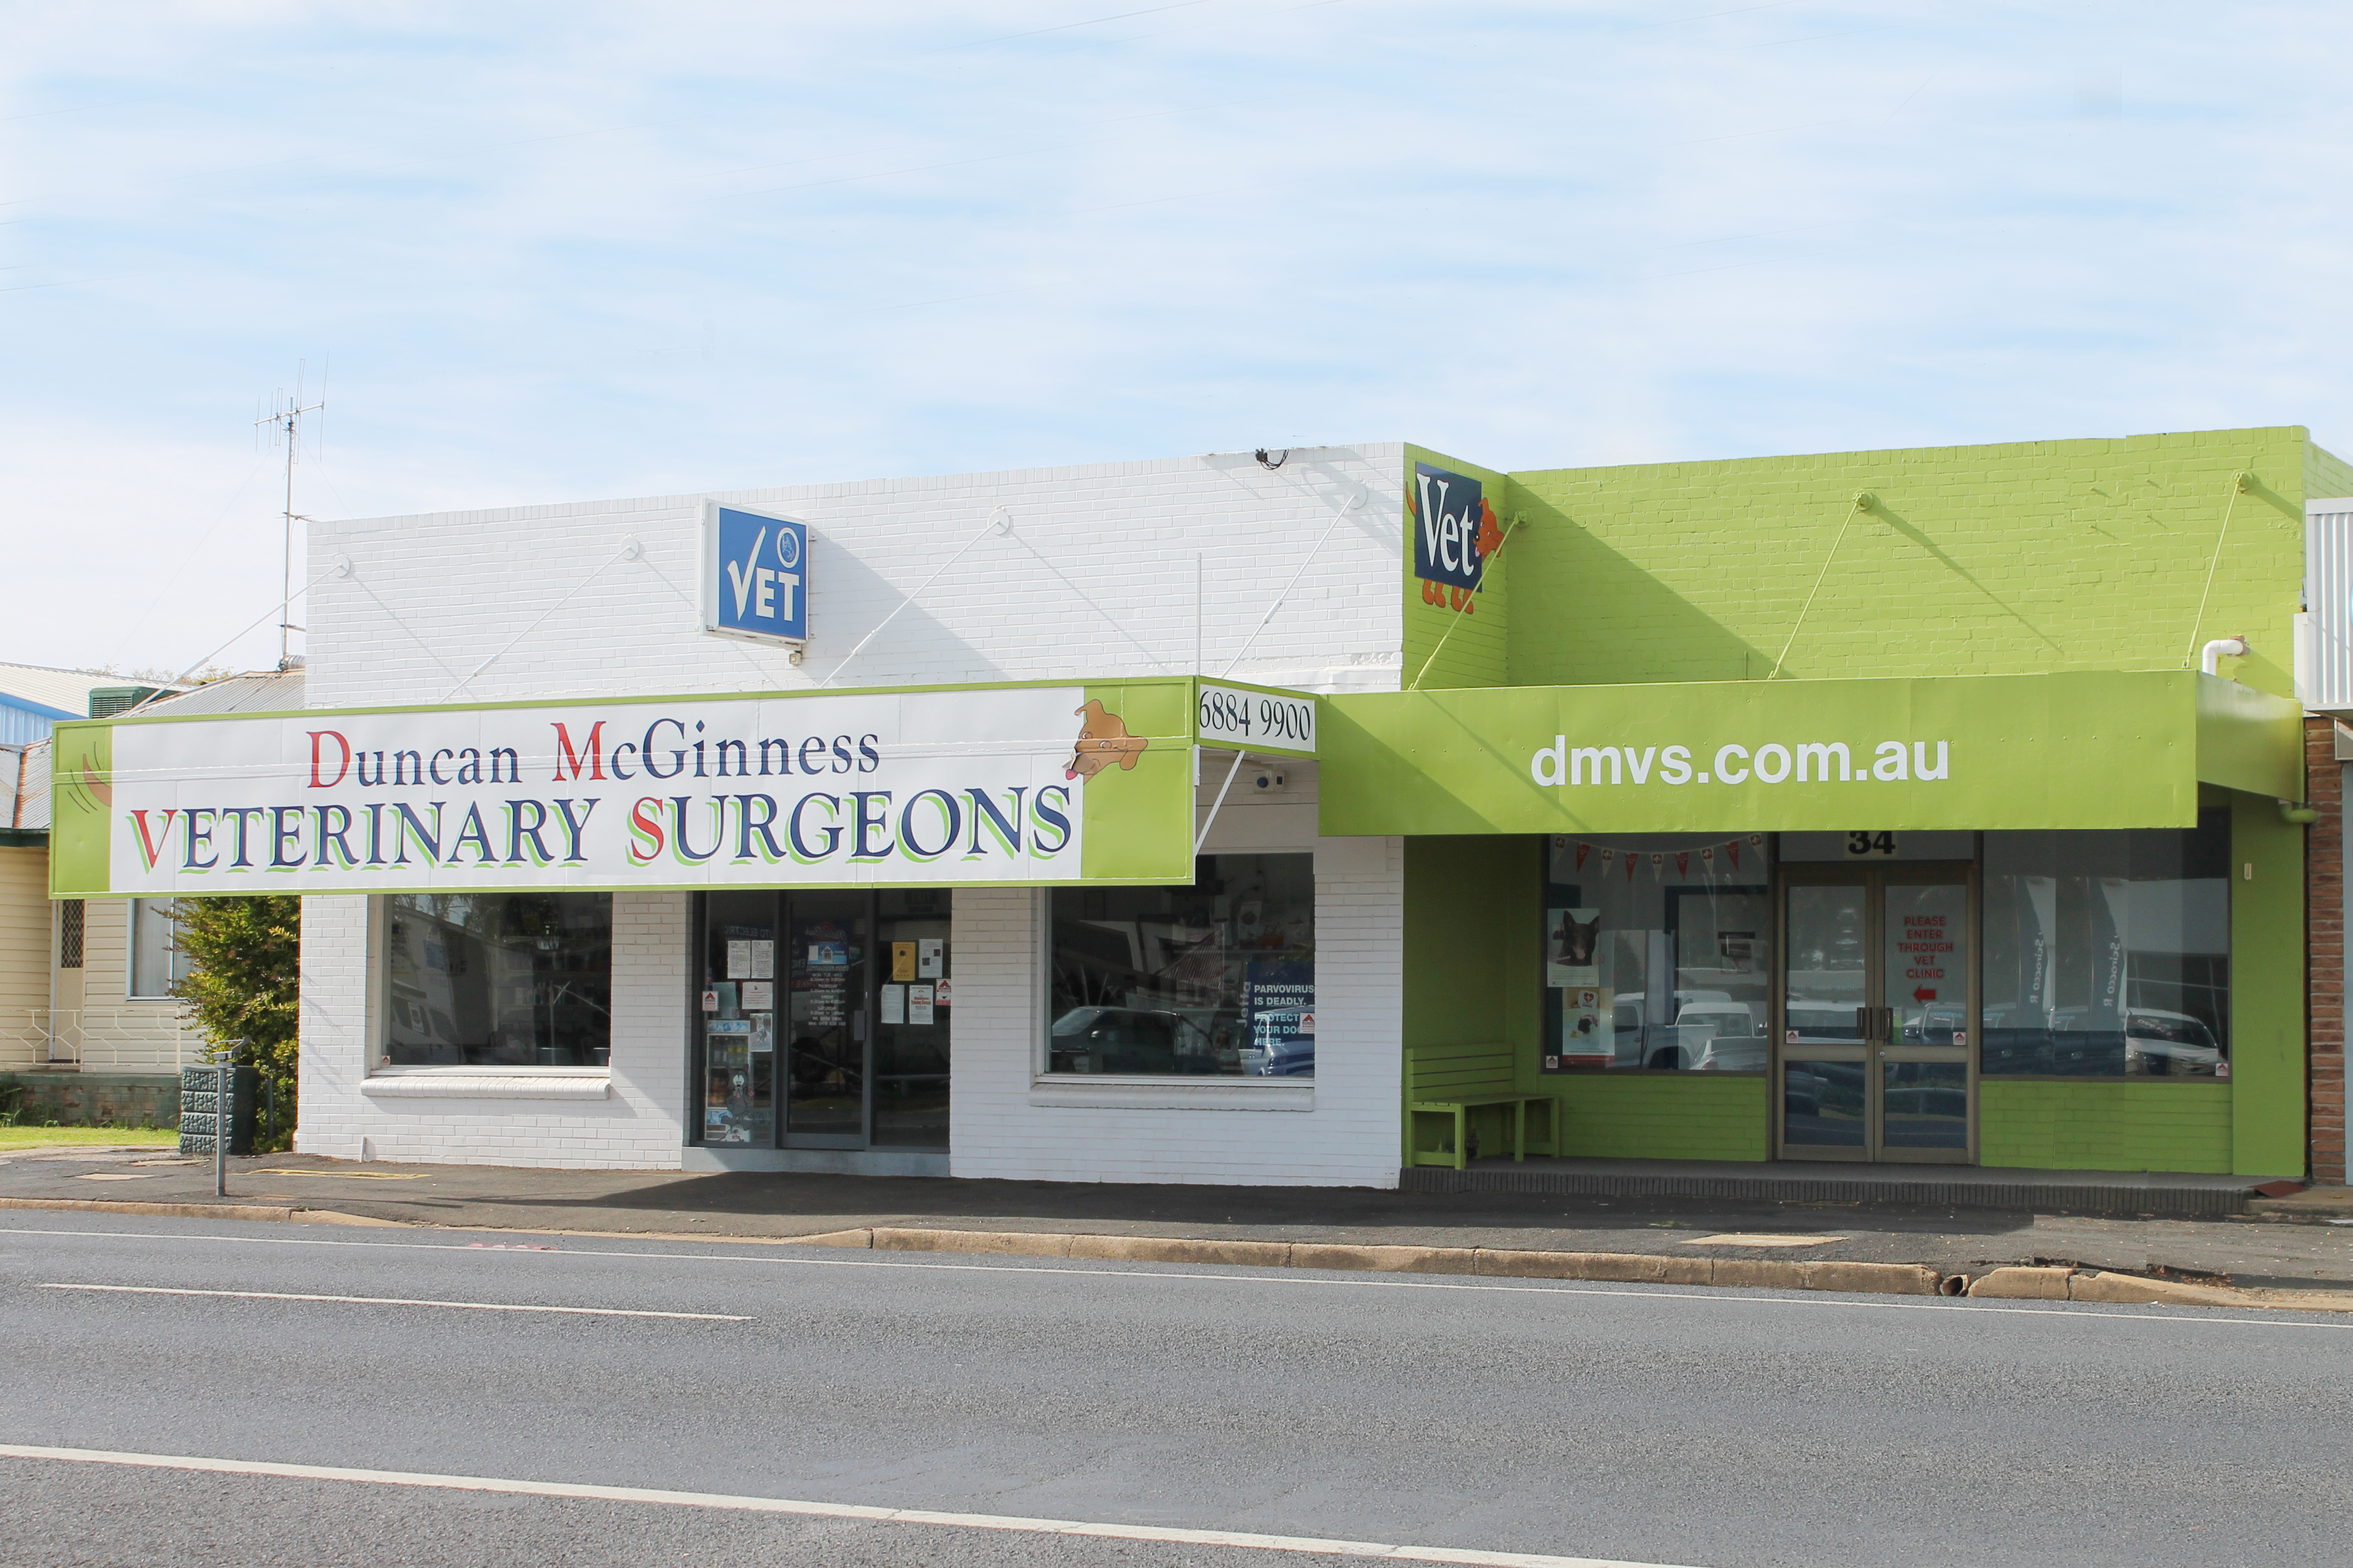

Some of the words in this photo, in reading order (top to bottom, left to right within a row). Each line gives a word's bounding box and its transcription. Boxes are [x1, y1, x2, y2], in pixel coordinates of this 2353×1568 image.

[1417, 473, 1474, 576] Vet
[727, 526, 800, 622] VET
[1199, 691, 1250, 737] 6884
[1260, 699, 1311, 741] 9900
[306, 730, 523, 788] Duncan
[550, 717, 879, 781] McGinness
[1530, 734, 1949, 787] dmvs.com.au
[128, 797, 601, 874] VETERINARY
[626, 784, 1071, 867] SURGEONS
[1849, 831, 1896, 854] 34
[1905, 916, 1946, 926] PLEASE
[1907, 929, 1943, 938] ENTER
[1898, 942, 1954, 951] THROUGH
[1914, 955, 1935, 964] VET
[1906, 969, 1944, 978] CLINIC
[1254, 985, 1315, 993] PARVOVIRUS
[1254, 997, 1264, 1005] IS
[1266, 997, 1306, 1006] DEADLY.
[1254, 1013, 1299, 1022] PROTECT
[1253, 1025, 1280, 1034] YOUR
[1254, 1038, 1285, 1046] HERE.
